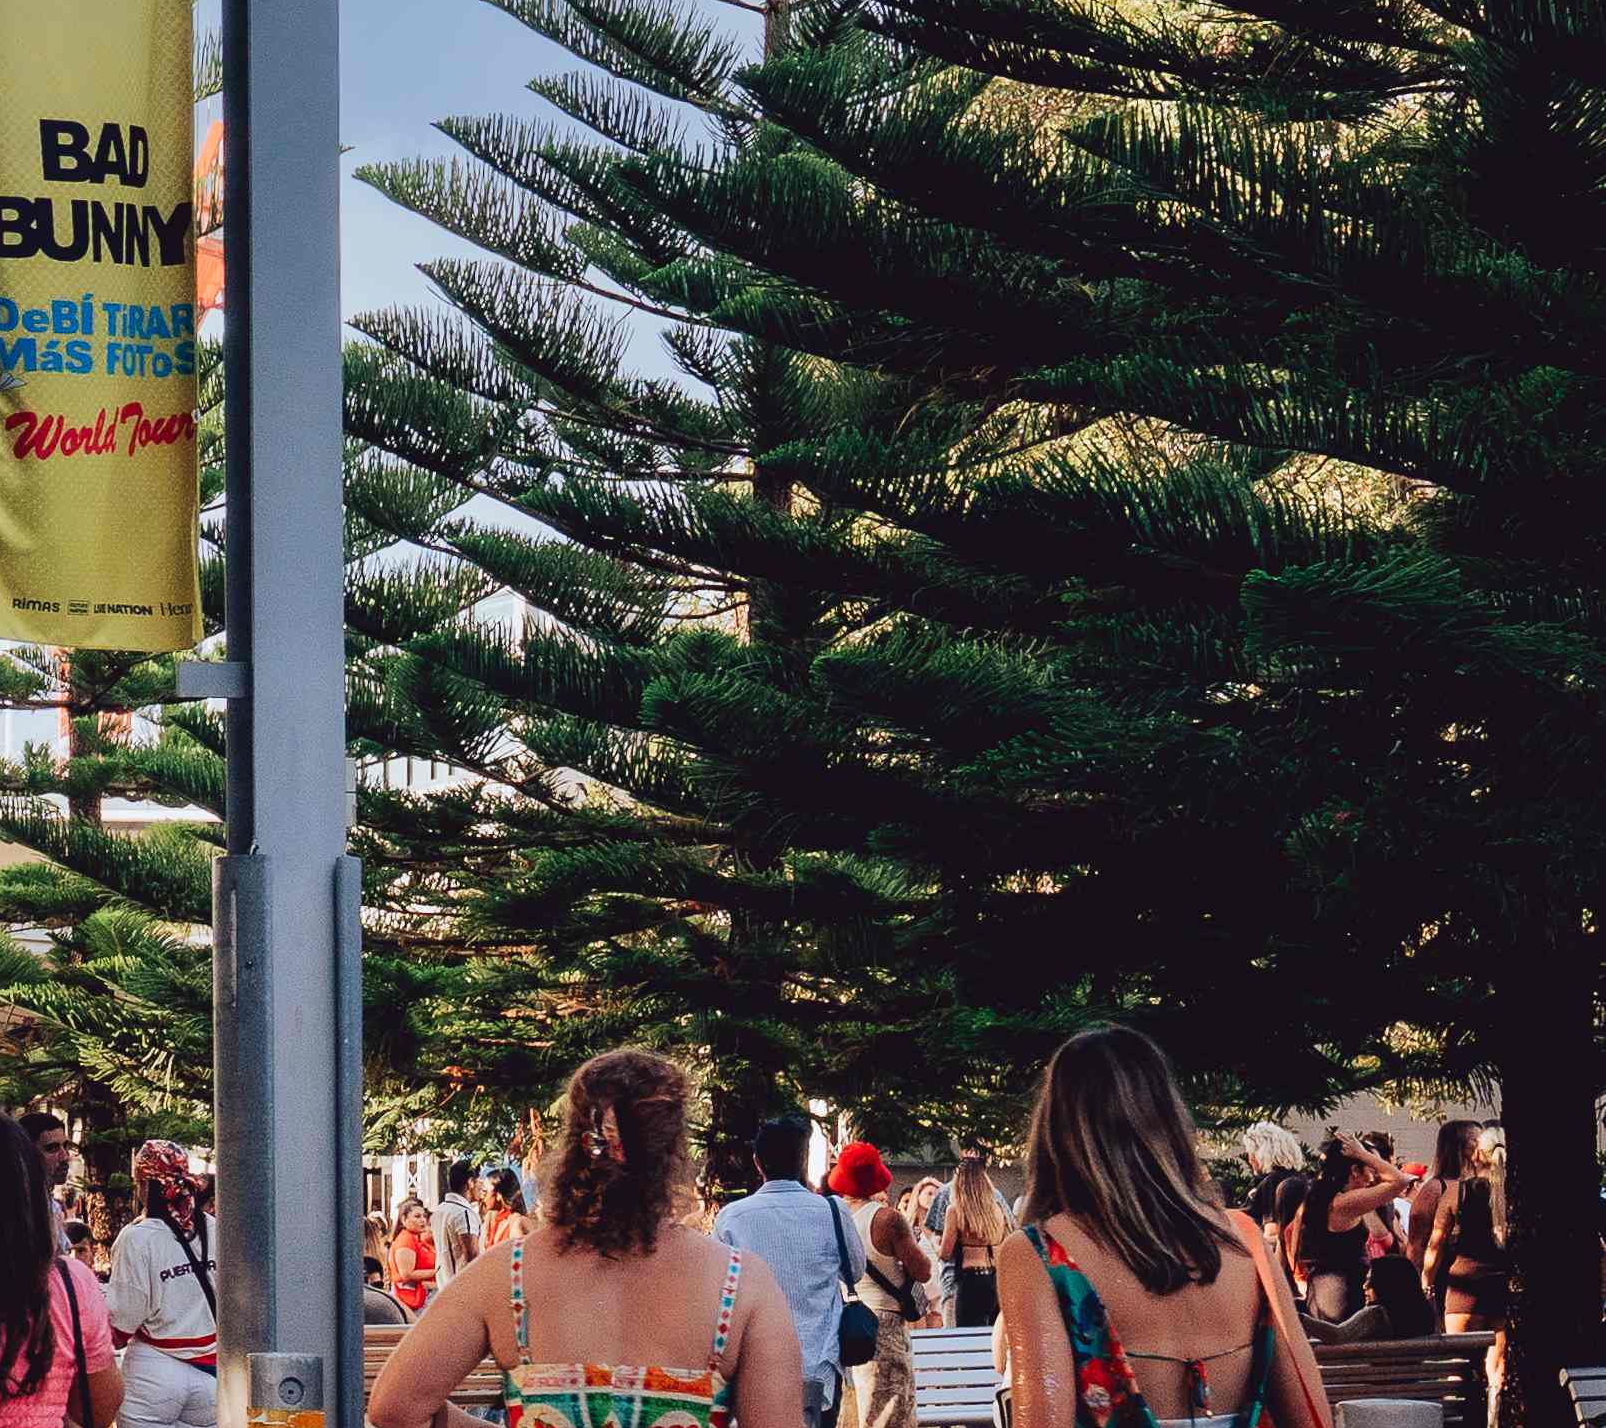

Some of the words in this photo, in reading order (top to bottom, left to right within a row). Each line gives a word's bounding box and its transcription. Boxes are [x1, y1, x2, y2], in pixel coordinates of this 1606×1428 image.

[39, 119, 149, 188] BAD
[5, 405, 116, 461] World
[120, 401, 196, 457] Tour
[107, 604, 153, 616] NATION
[160, 1263, 192, 1282] PUER
